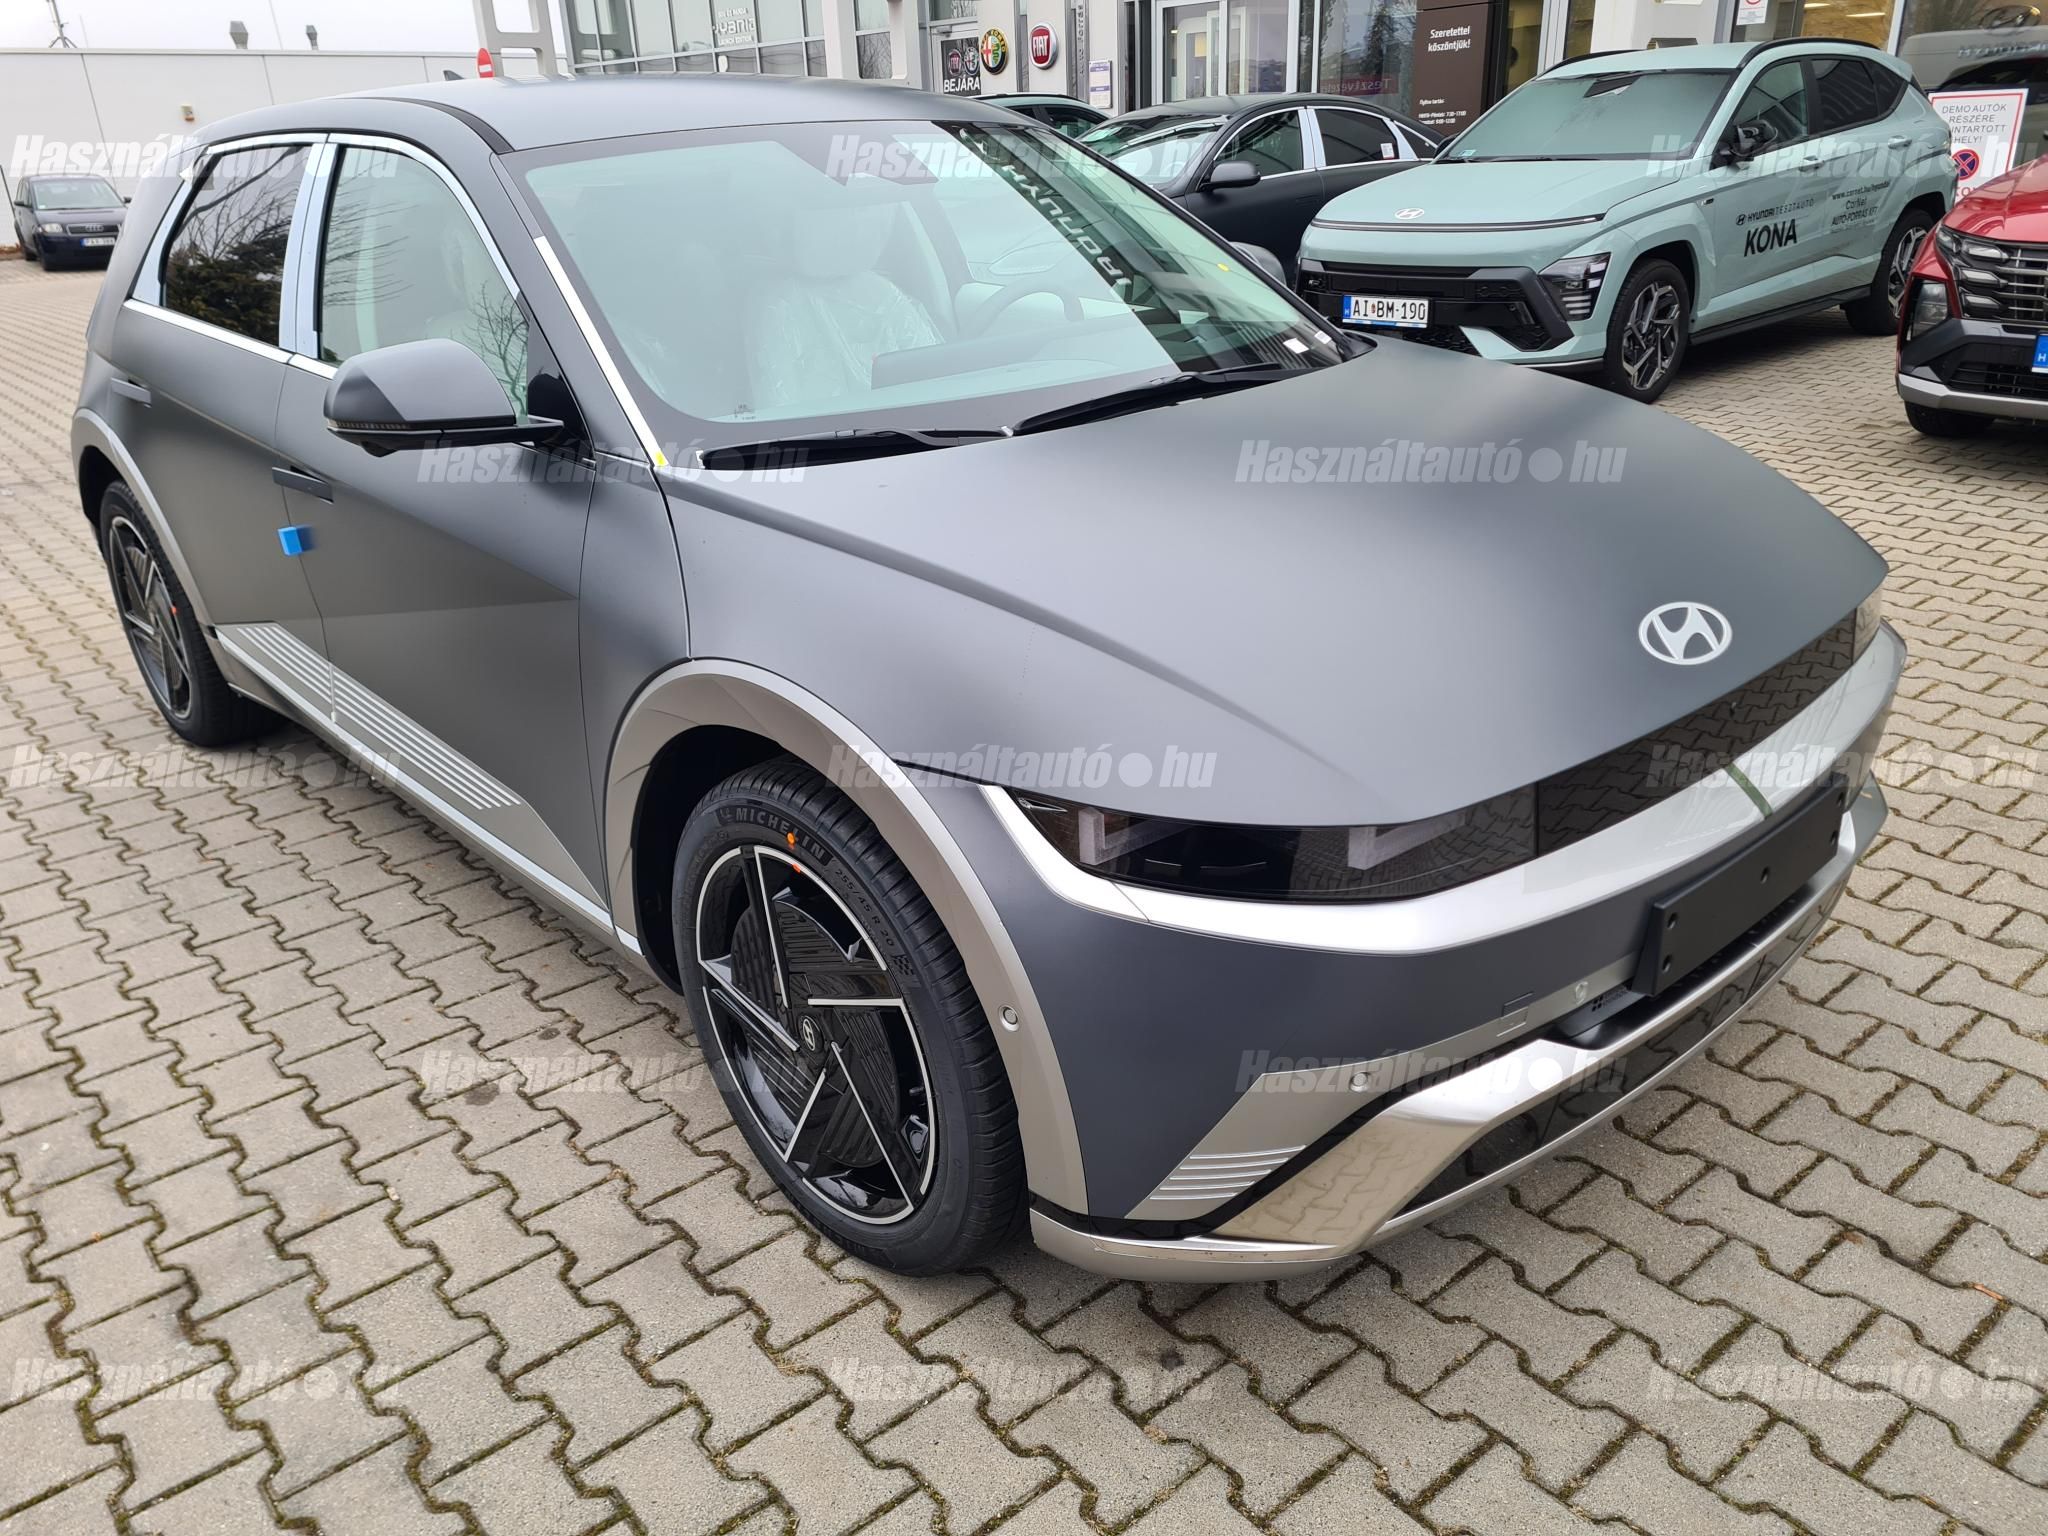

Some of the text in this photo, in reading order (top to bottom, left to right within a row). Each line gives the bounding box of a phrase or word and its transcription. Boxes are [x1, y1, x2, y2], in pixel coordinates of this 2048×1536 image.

[1430, 26, 1470, 38] Szeretettel
[1032, 35, 1049, 57] FIAT
[1428, 38, 1471, 52] köszöntjük!
[1942, 105, 1971, 114] DEMO
[1953, 135, 1982, 144] HELY!
[1743, 218, 1798, 257] KONA
[1376, 301, 1426, 321] BM-190
[735, 807, 826, 859] MICHELIN
